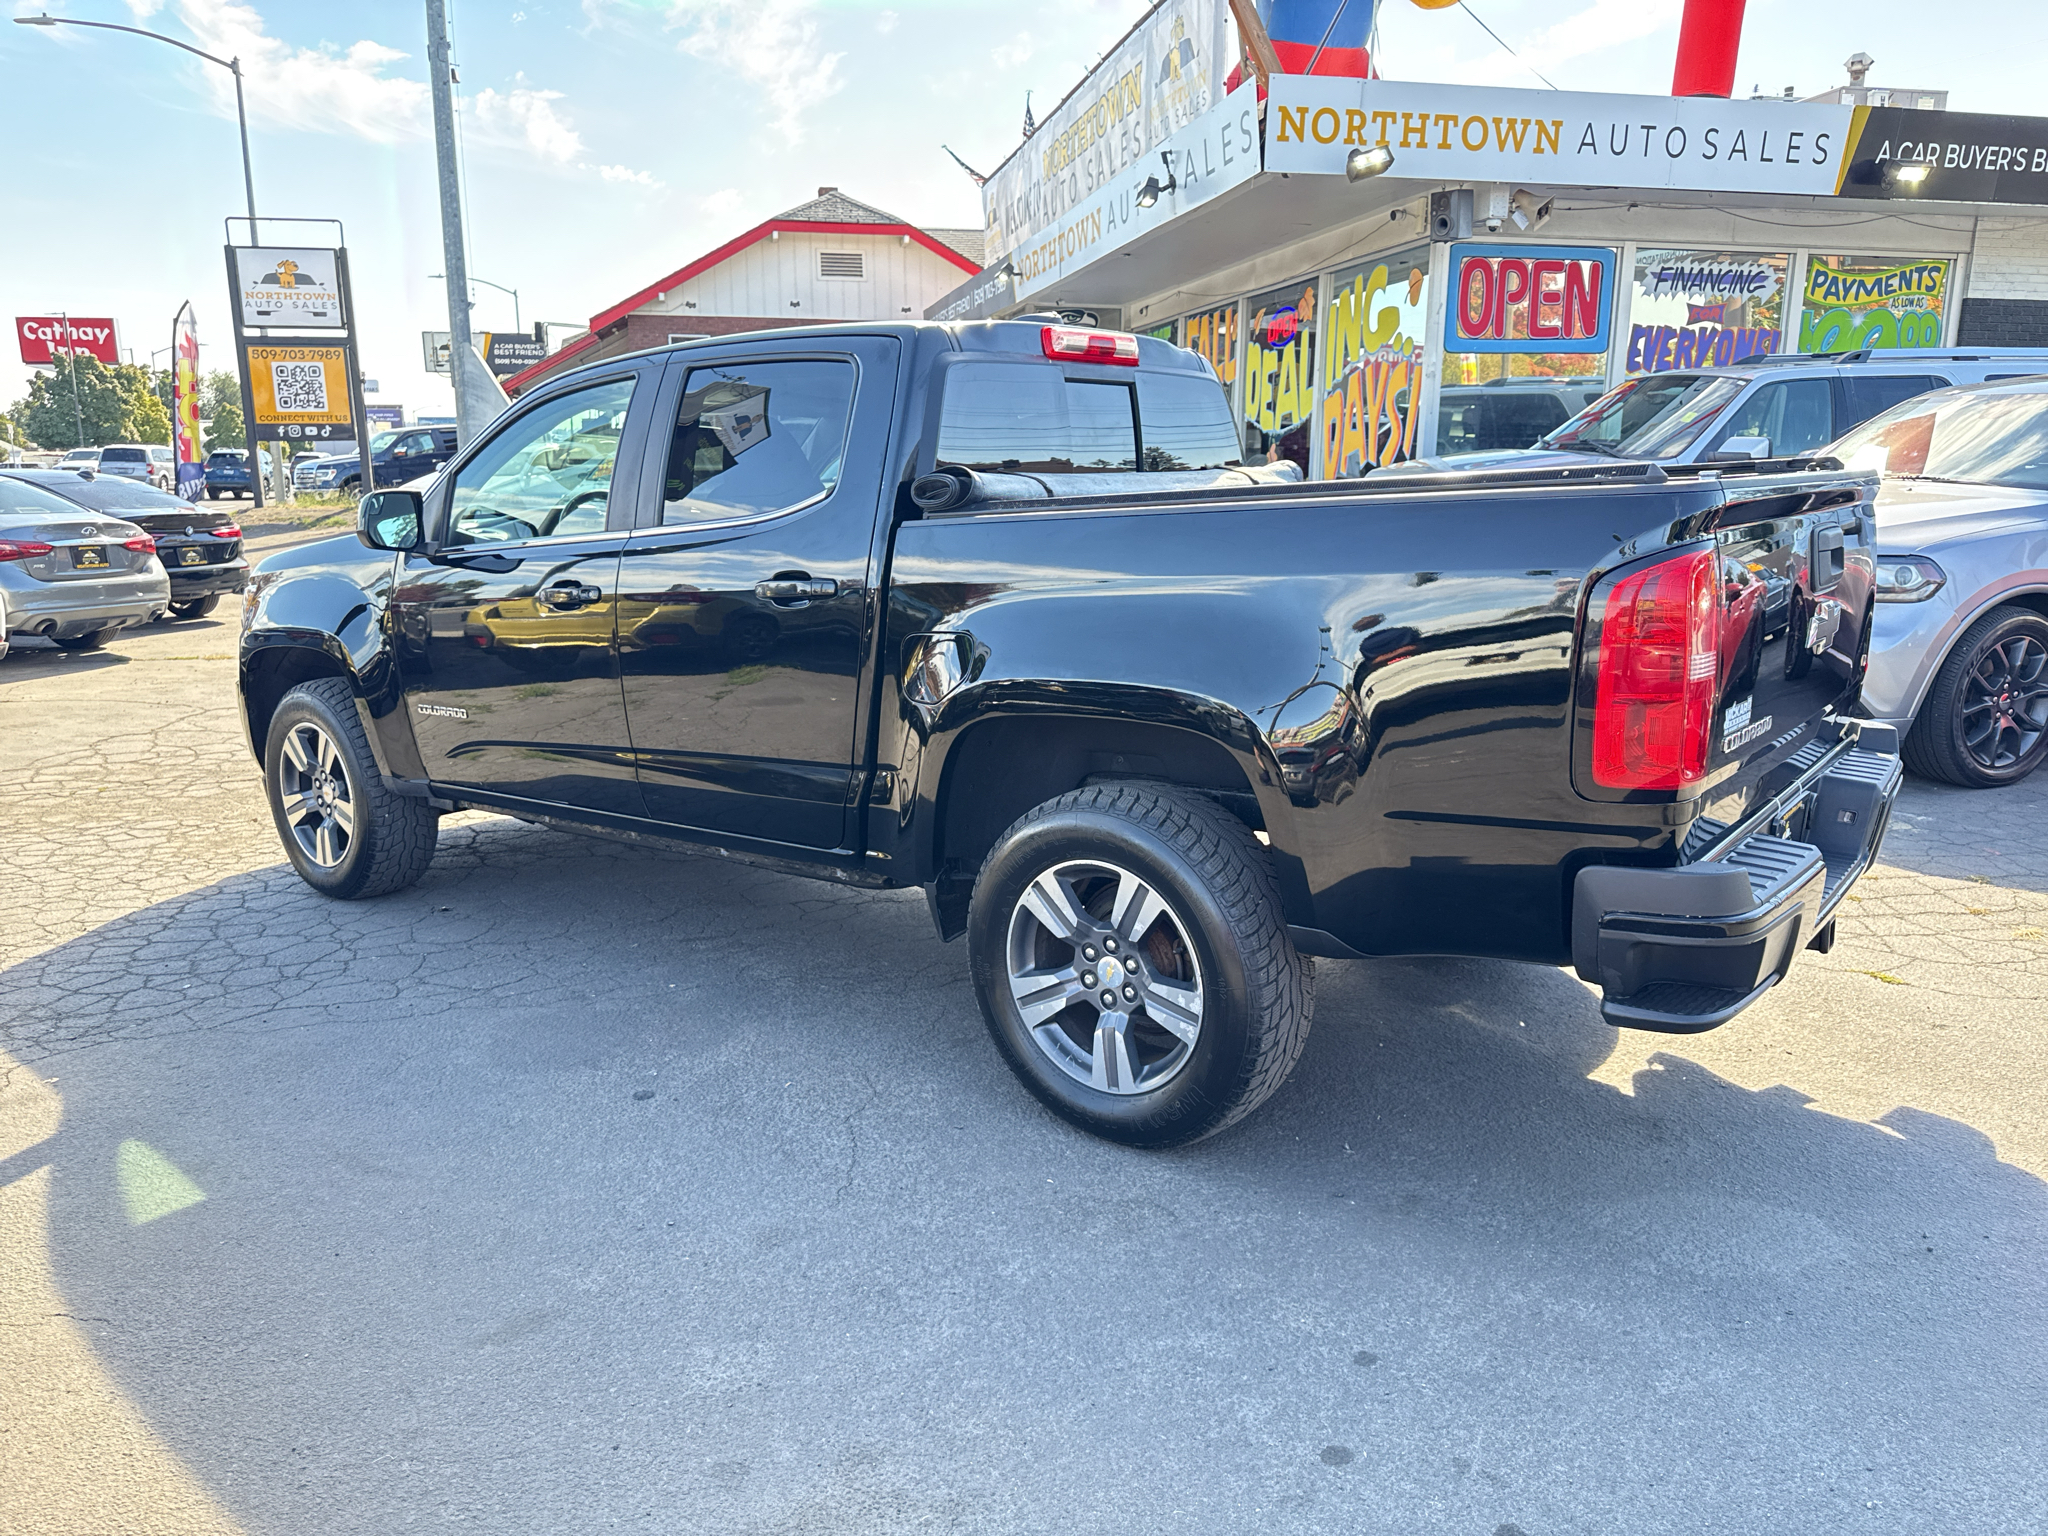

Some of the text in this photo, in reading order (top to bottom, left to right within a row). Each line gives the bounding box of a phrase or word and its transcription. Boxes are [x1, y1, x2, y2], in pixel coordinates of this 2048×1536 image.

[1042, 61, 1142, 186] NORTHTOWN
[1175, 90, 1207, 124] SALES
[1277, 105, 1830, 165] NORTHTOWN AUTO SALES
[1042, 121, 1141, 224] AUTO SALES
[1874, 140, 2048, 173] A CAR BUYER'S B
[1016, 206, 1102, 287] NORTHTOWN
[1168, 109, 1252, 192] ALES
[244, 291, 336, 301] NORTHTOWN
[1654, 266, 1767, 294] FINANCING
[1811, 265, 1942, 302] PAYMENTS
[244, 300, 338, 310] AUTO SALES
[1458, 257, 1602, 339] OPEN
[1690, 307, 1721, 321] FOR
[1891, 297, 1924, 309] AS LOW AS
[23, 321, 110, 345] Cathay
[1267, 311, 1298, 343] OPEN
[251, 349, 341, 360] 509-703-7989
[1187, 306, 1238, 385] FALL
[1626, 323, 1782, 374] EVERYONE!
[1245, 327, 1313, 432] DEAL
[259, 414, 306, 422] CONNECT
[308, 414, 333, 422] WITH
[1323, 360, 1422, 480] DAYS!
[418, 704, 469, 719] COLORADO
